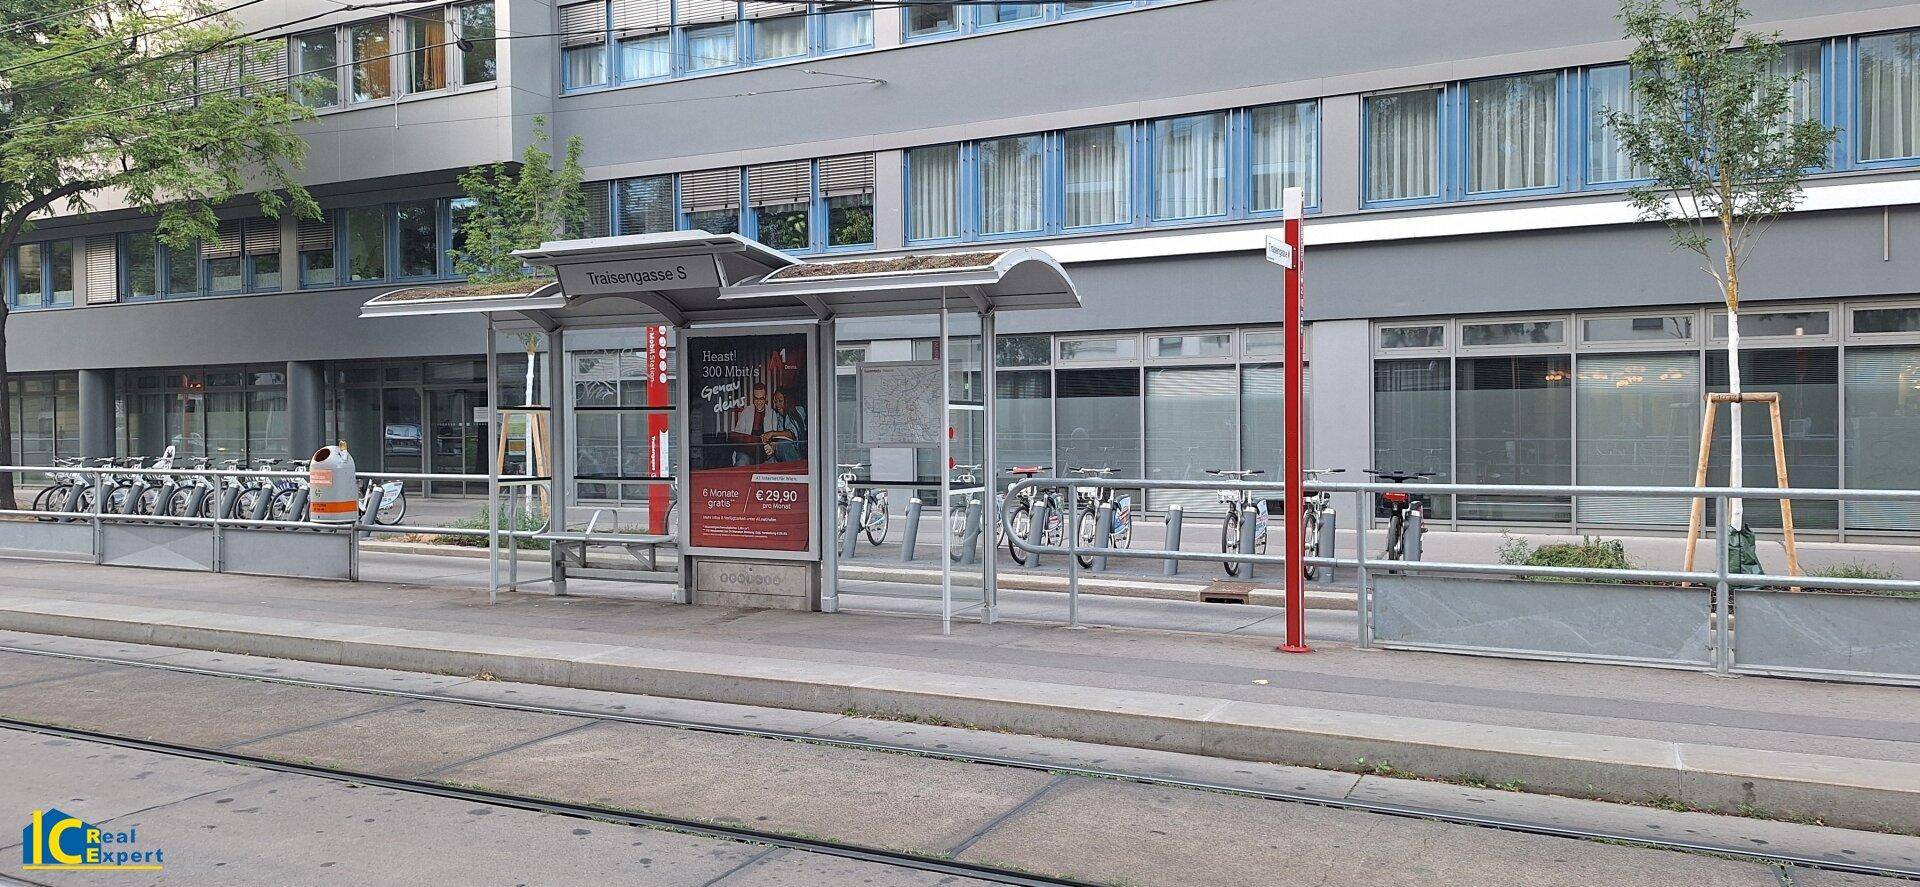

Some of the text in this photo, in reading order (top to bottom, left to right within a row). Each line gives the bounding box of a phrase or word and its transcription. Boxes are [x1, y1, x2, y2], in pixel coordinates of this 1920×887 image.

[586, 265, 687, 286] Traisengasse S
[702, 350, 737, 362] Heast!
[768, 347, 786, 372] A1
[702, 366, 722, 378] 300
[701, 380, 741, 402] Genau
[713, 395, 747, 413] deins
[702, 488, 739, 499] 6 Monate
[755, 490, 798, 503] € 29,90
